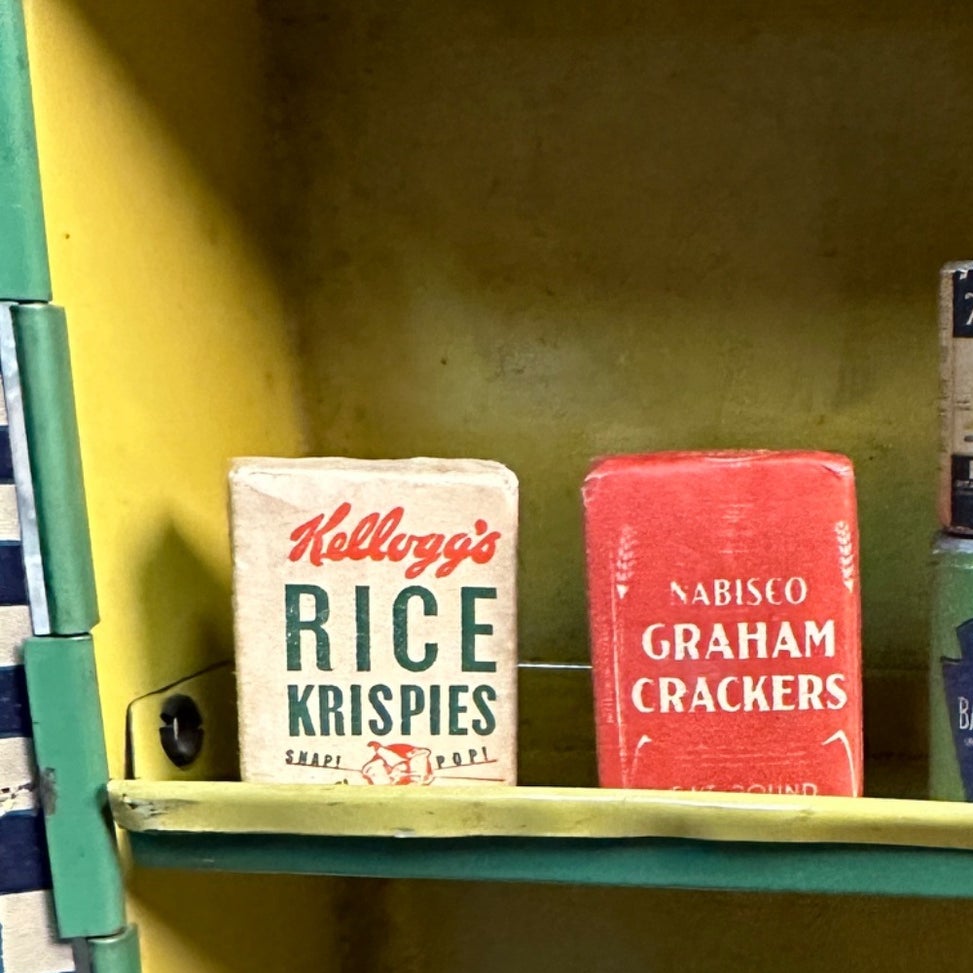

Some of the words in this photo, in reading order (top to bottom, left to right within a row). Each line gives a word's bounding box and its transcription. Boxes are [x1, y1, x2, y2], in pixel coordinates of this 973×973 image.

[288, 502, 501, 579] Kellogg's
[671, 577, 807, 606] NABISCO
[285, 584, 497, 673] RICE
[642, 620, 835, 660] GRAHAM
[287, 684, 496, 736] KRISPIES
[631, 673, 848, 713] CRACKERS
[285, 749, 341, 769] SNAP!
[436, 746, 489, 769] POP!
